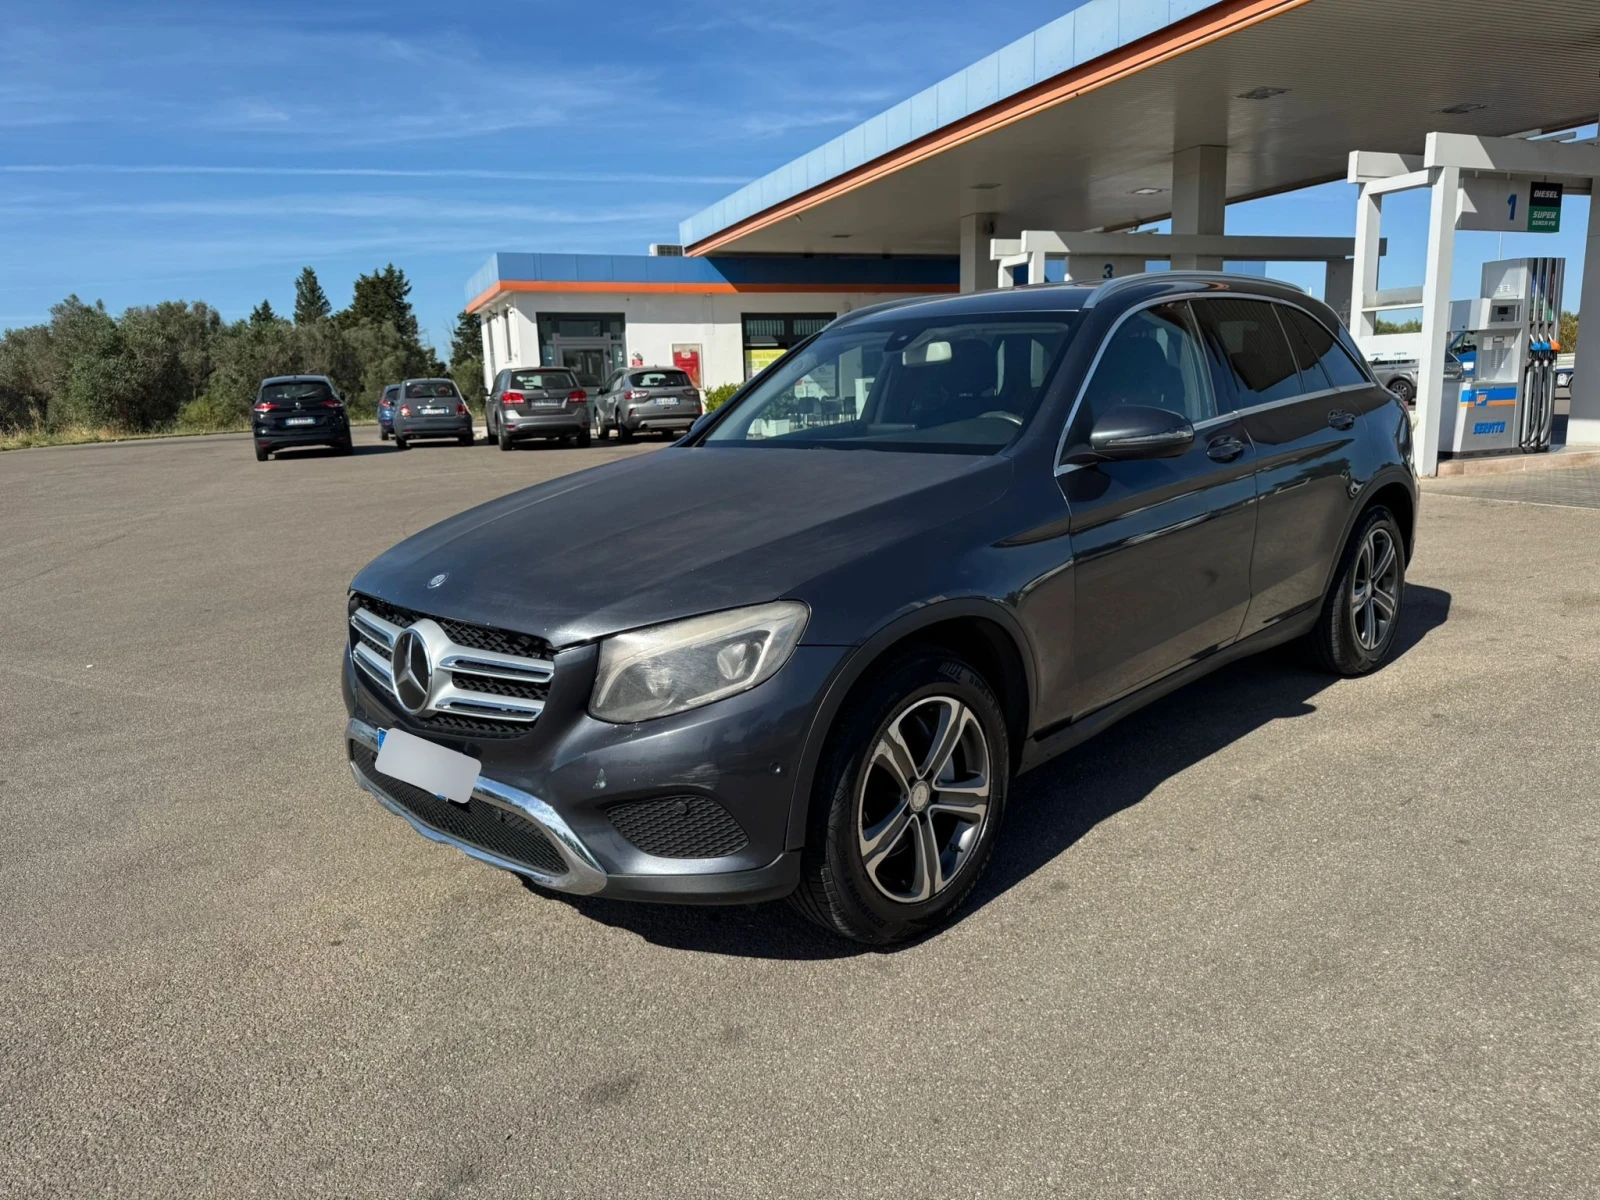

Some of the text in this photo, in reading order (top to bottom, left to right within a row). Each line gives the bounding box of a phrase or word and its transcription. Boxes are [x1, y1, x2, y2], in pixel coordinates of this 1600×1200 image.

[1533, 190, 1558, 198] DIESEL
[1507, 194, 1517, 220] 1
[1102, 263, 1114, 279] 3
